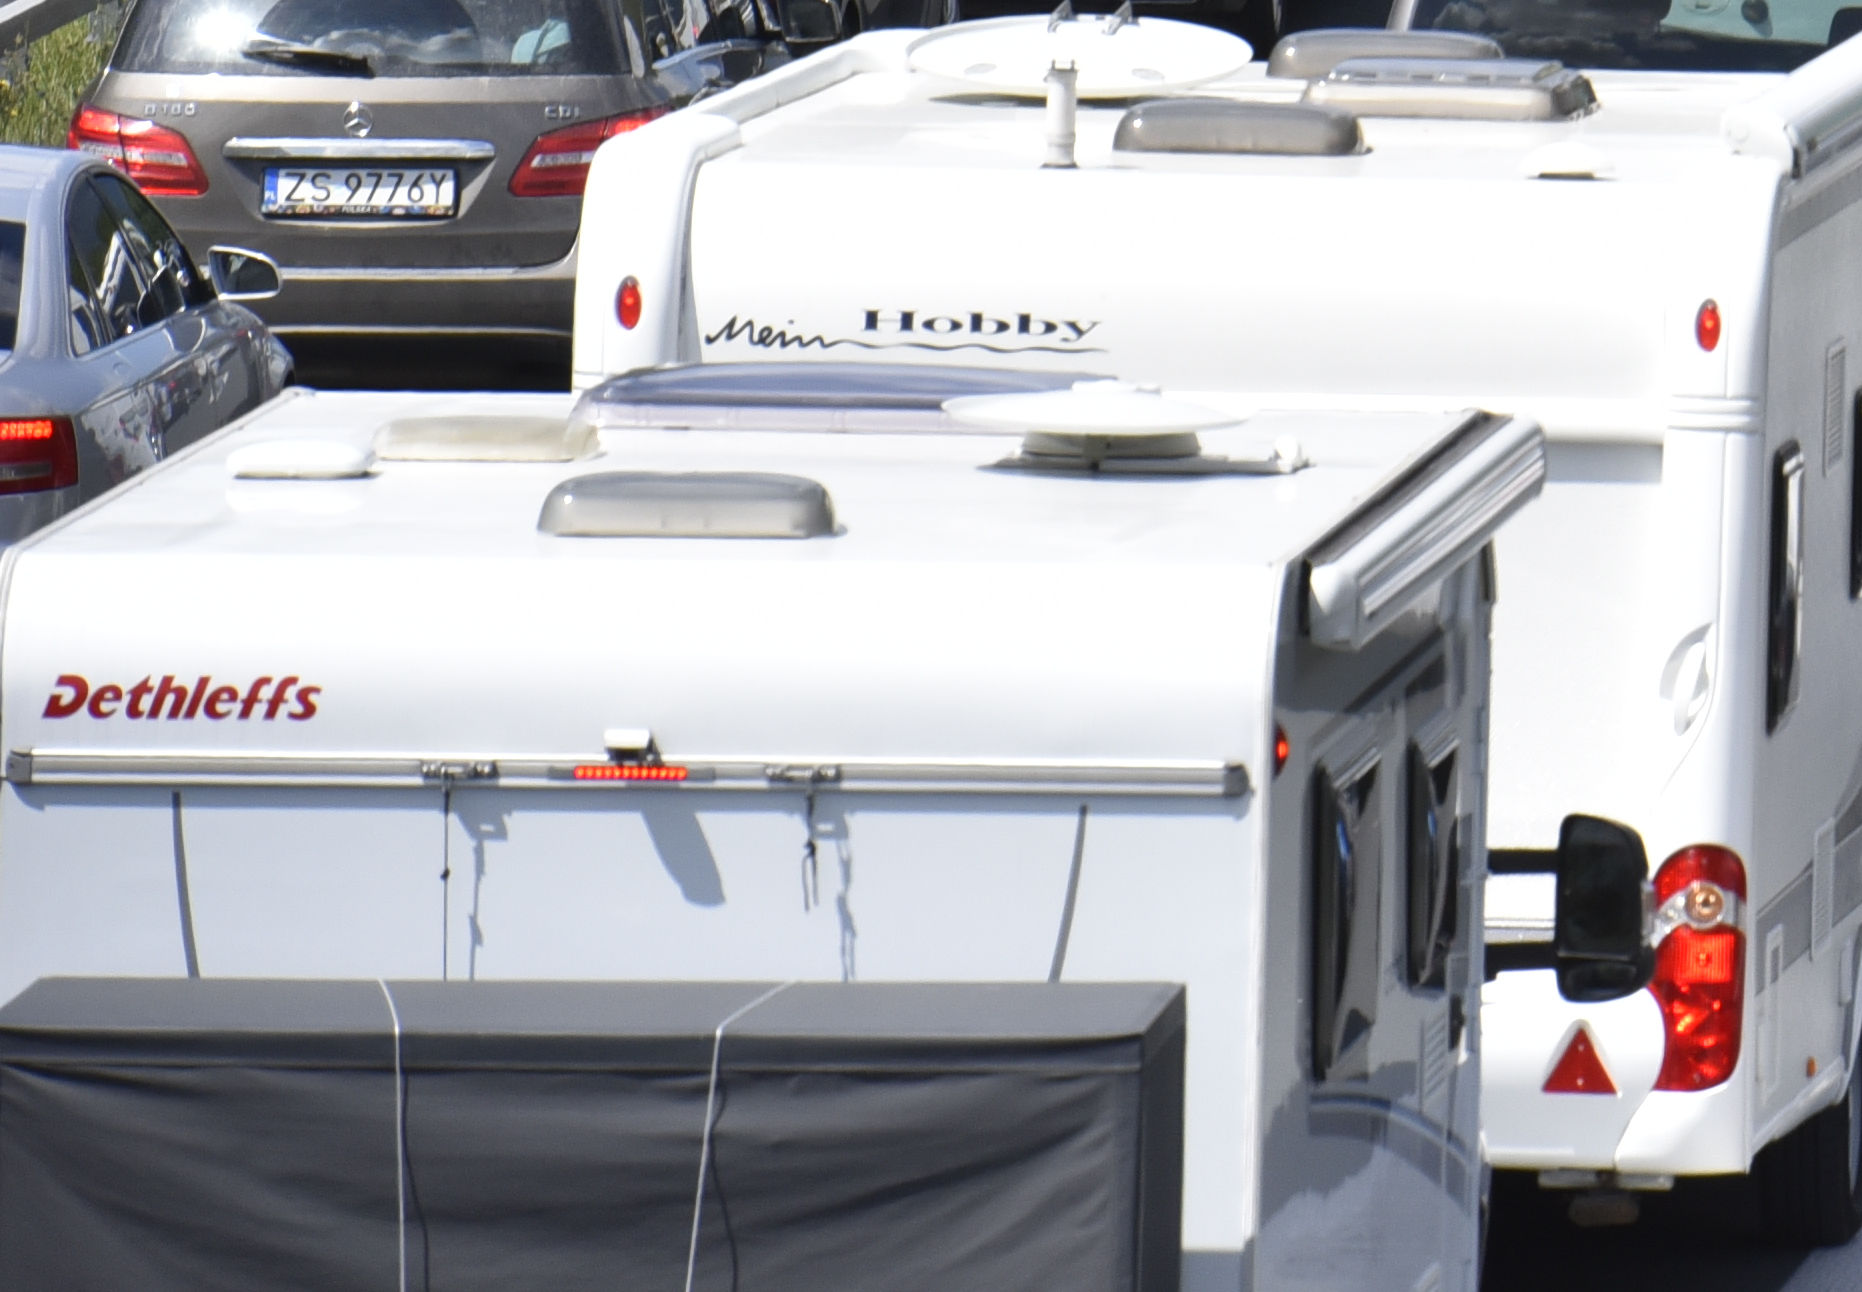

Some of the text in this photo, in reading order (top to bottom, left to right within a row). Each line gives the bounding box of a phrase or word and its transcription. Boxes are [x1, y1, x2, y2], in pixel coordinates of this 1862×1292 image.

[284, 172, 448, 203] ZS 9776Y
[704, 308, 1103, 349] Mein Hobby
[42, 673, 322, 722] Dethleffs
